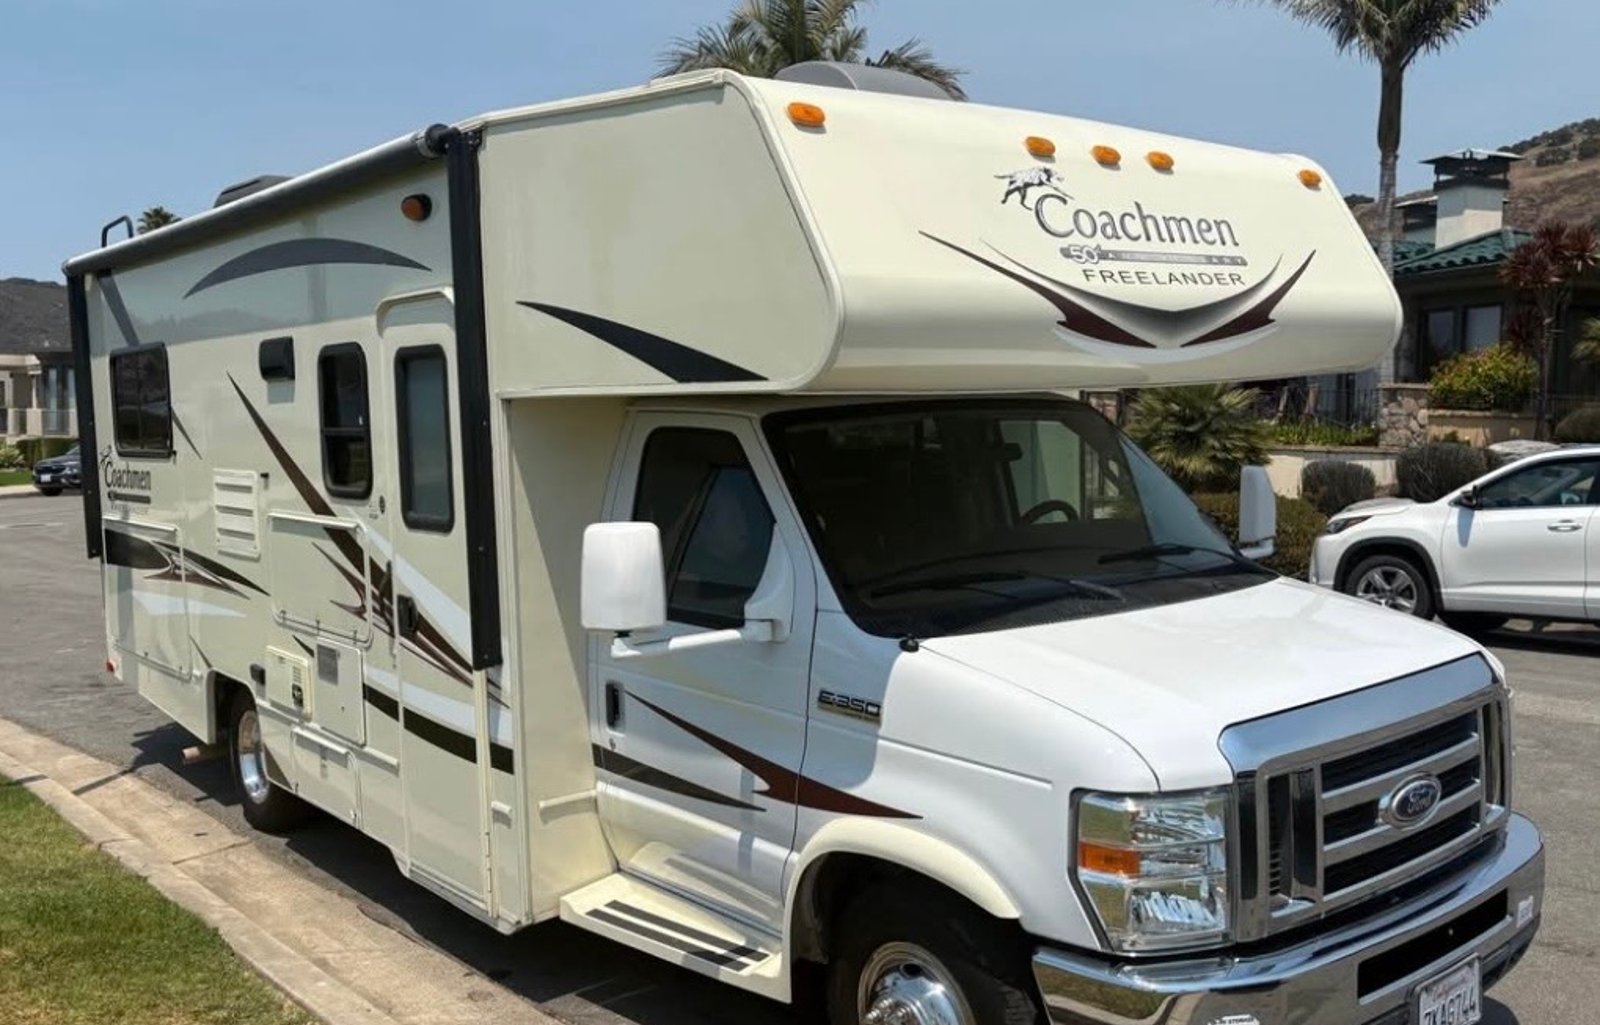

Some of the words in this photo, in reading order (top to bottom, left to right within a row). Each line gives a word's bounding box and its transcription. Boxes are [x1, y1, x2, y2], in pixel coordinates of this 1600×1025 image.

[1034, 194, 1240, 247] Coachmen
[1082, 269, 1246, 286] FREELANDER
[104, 461, 151, 490] Coachmen
[817, 689, 882, 717] E-350
